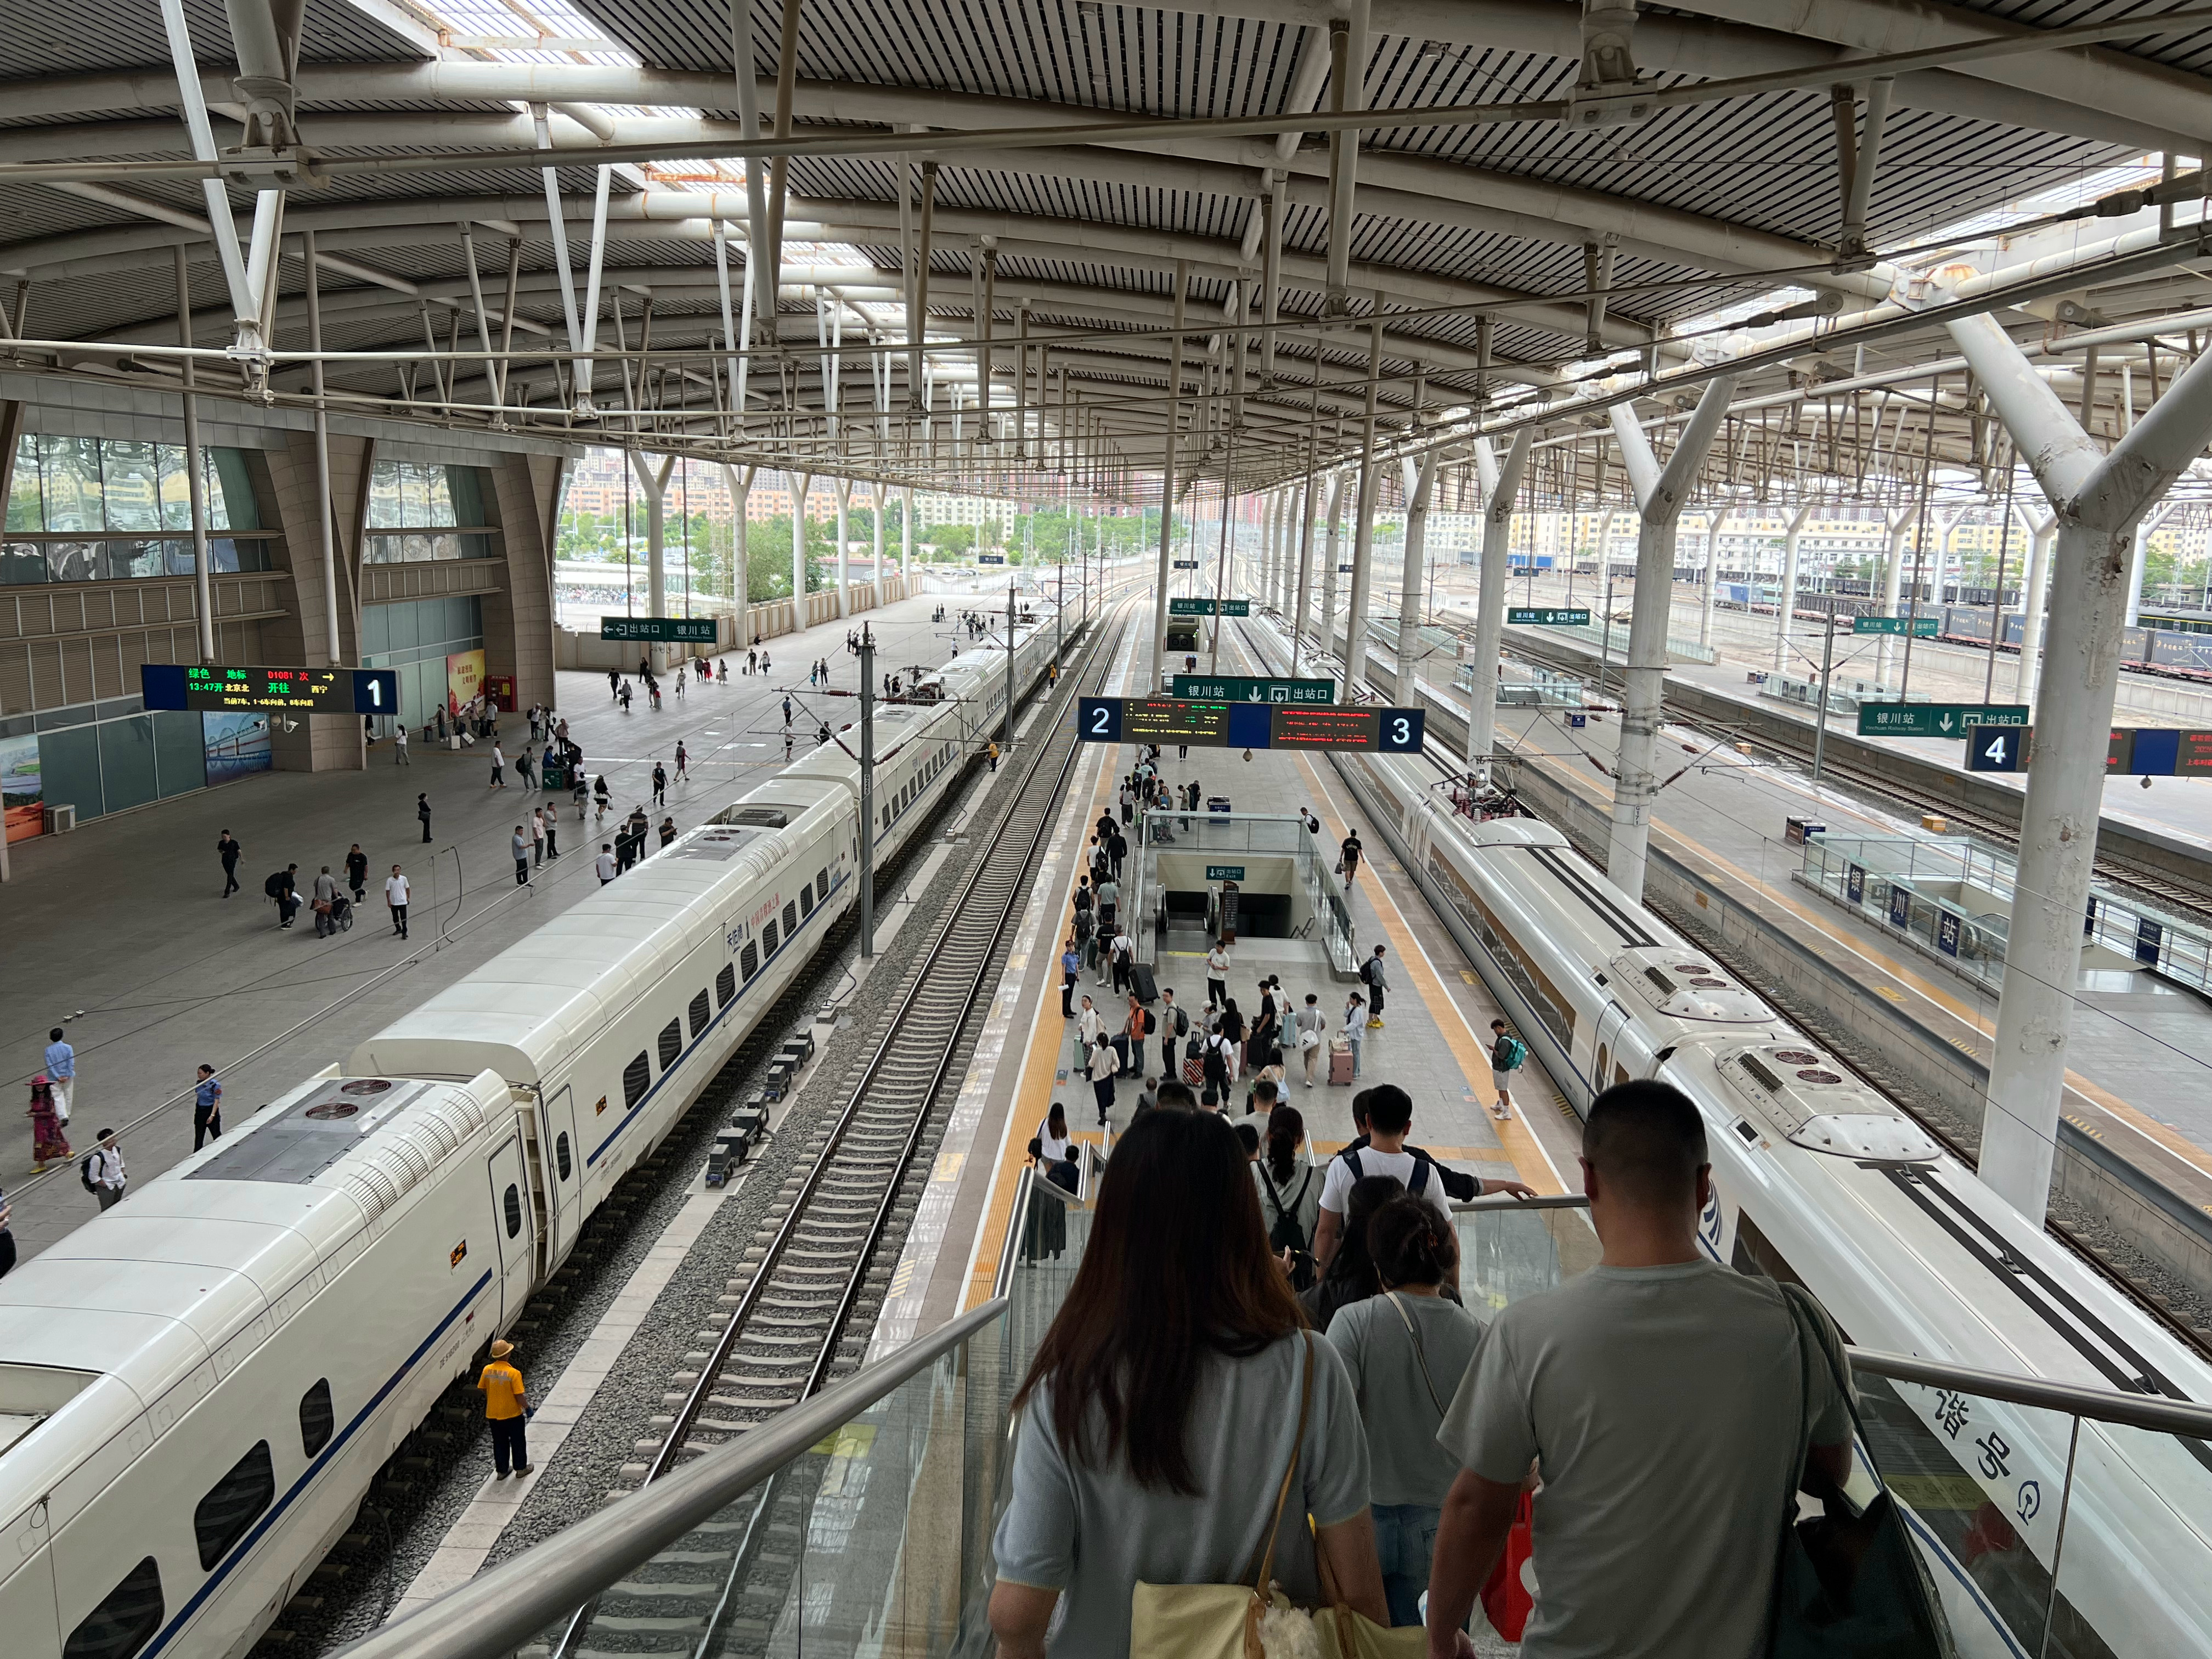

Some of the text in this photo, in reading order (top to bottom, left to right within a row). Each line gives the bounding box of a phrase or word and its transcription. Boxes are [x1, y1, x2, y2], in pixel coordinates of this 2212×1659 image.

[630, 624, 660, 634] 出站口
[676, 625, 711, 636] 银川站
[189, 668, 211, 680] 绿色
[226, 670, 247, 680] 地标
[299, 672, 309, 681] 次
[225, 683, 250, 692] 北京北
[268, 682, 291, 694] 开往
[311, 685, 328, 694] 西宁
[367, 679, 380, 707] 1
[1188, 685, 1224, 697] 银川站
[1293, 688, 1328, 700] 出站口
[1091, 707, 1109, 733] 2
[1876, 712, 1915, 725] 银川站
[1986, 714, 2022, 725] 出站口
[1391, 718, 1410, 744] 3
[1984, 735, 2007, 764] 4
[1850, 868, 1861, 893] 银
[1894, 891, 1905, 917] 川
[1942, 917, 1956, 945] 站
